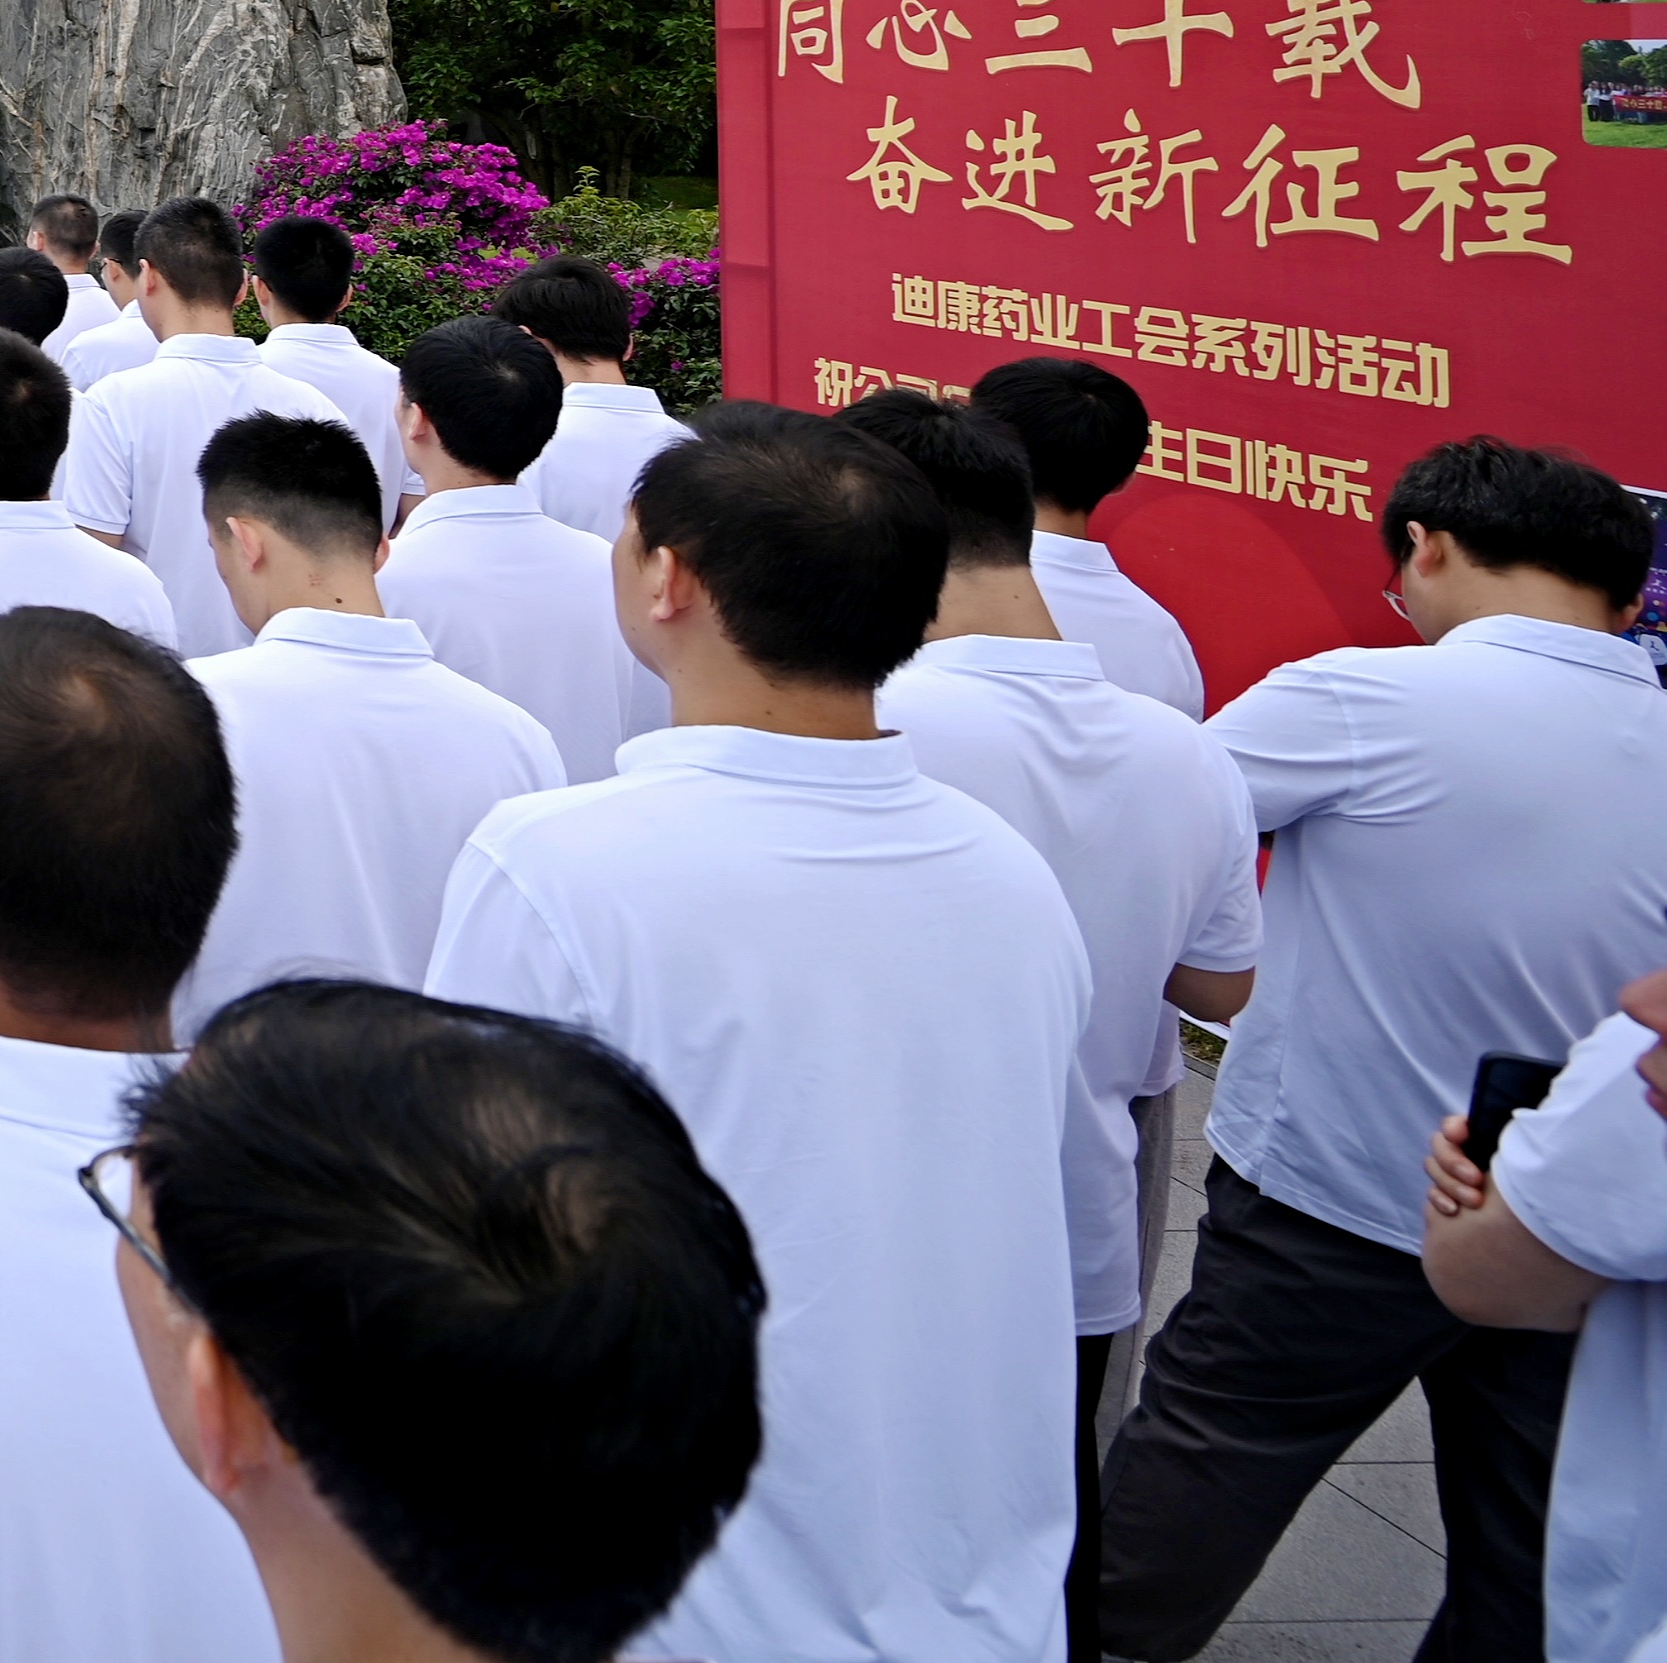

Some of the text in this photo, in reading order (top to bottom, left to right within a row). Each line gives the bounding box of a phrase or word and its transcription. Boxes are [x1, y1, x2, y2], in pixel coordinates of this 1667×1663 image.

[846, 94, 1573, 266] 奋进新征程
[891, 272, 1450, 408] 迪康药业工会系列活动
